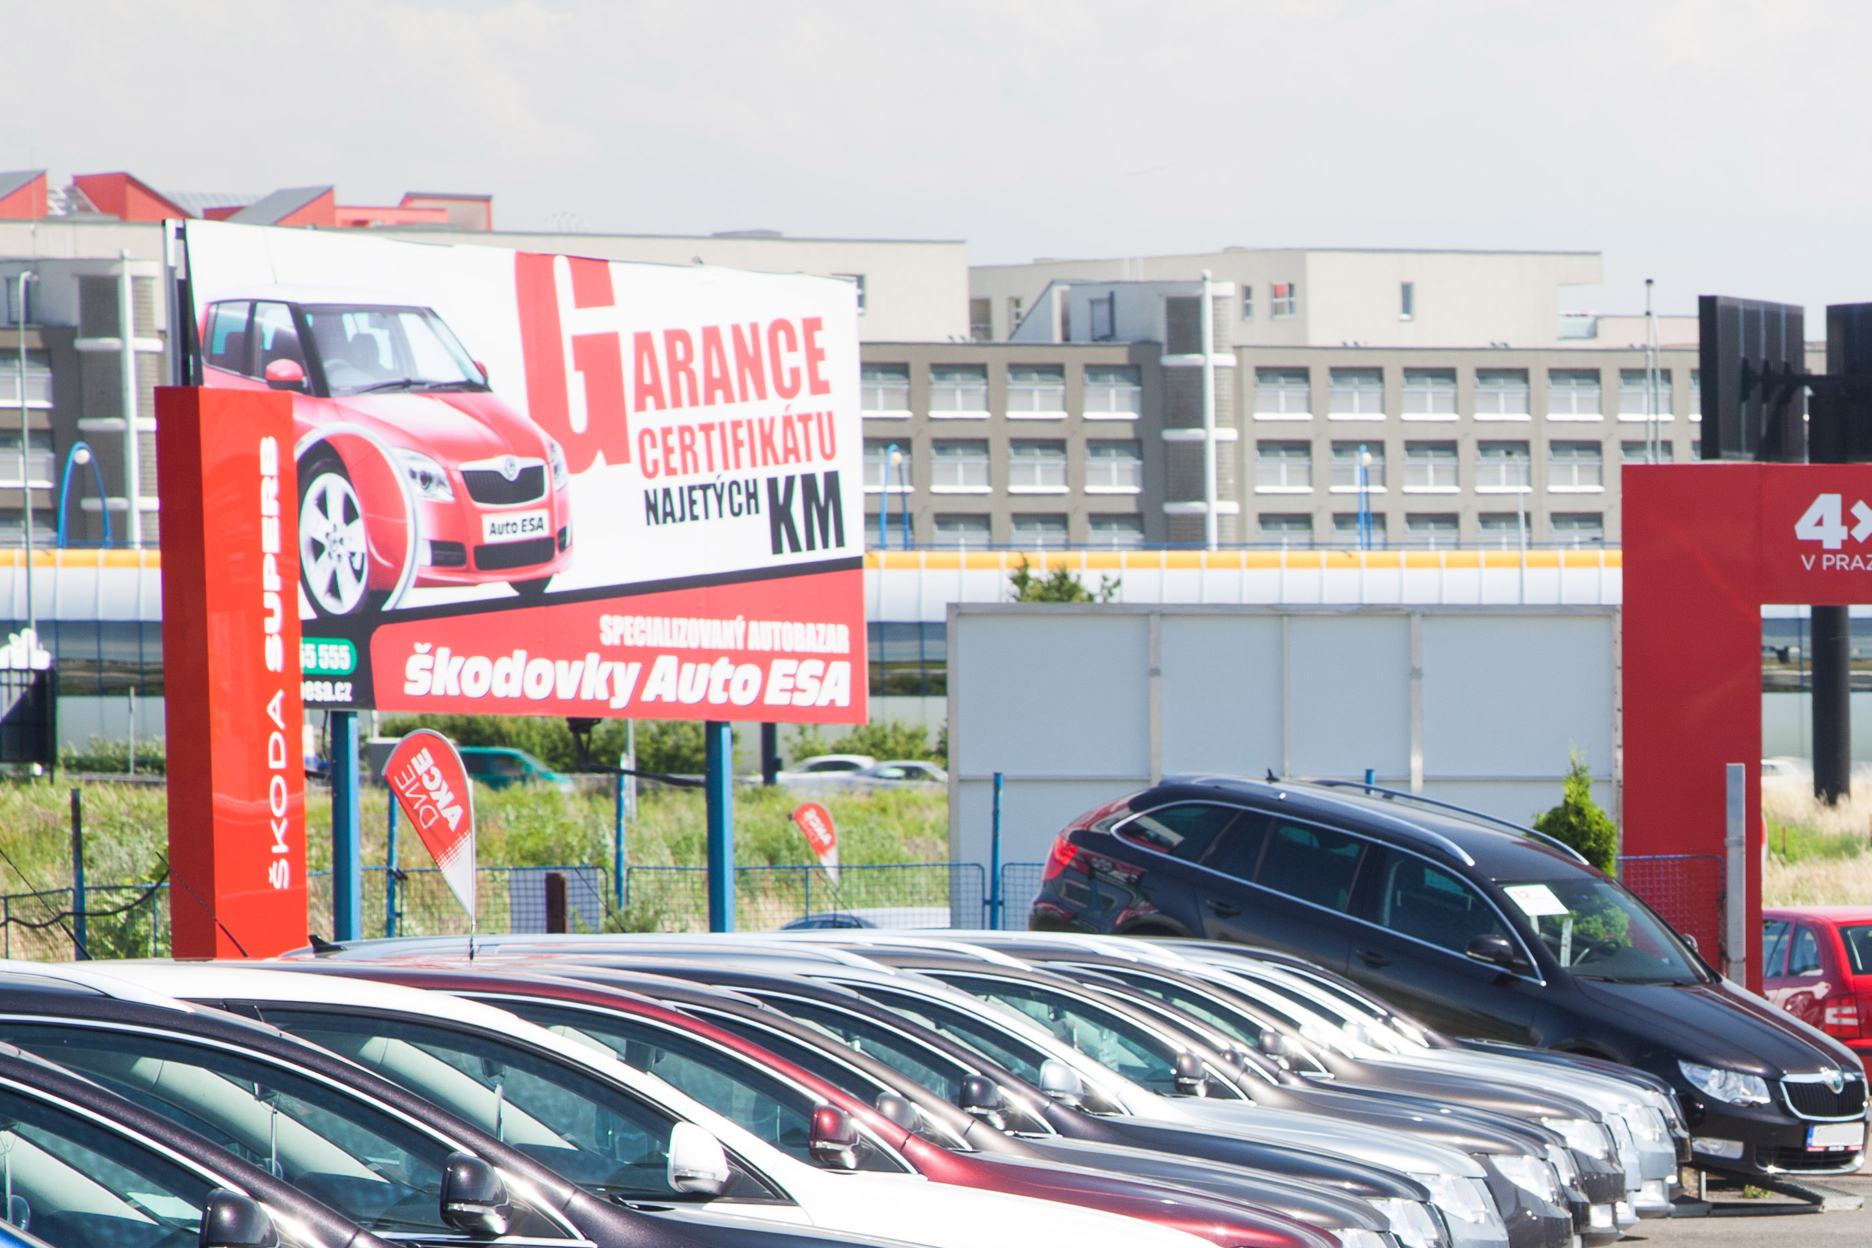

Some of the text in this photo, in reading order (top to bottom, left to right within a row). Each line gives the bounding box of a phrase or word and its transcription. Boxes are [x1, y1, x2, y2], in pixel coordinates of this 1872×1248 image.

[514, 250, 831, 474] GARANCE
[638, 404, 837, 479] CERTIFIKÁTU
[489, 517, 544, 536] Auto ESA
[644, 470, 845, 555] NAJETÝCH KM
[1801, 554, 1815, 571] V
[260, 436, 290, 890] ŠKODA SUPERB
[318, 644, 351, 670] 555
[600, 614, 850, 653] SPECIALIZOVANÝ AUTOBAZAR
[404, 642, 851, 710] škodovky Auto ESA
